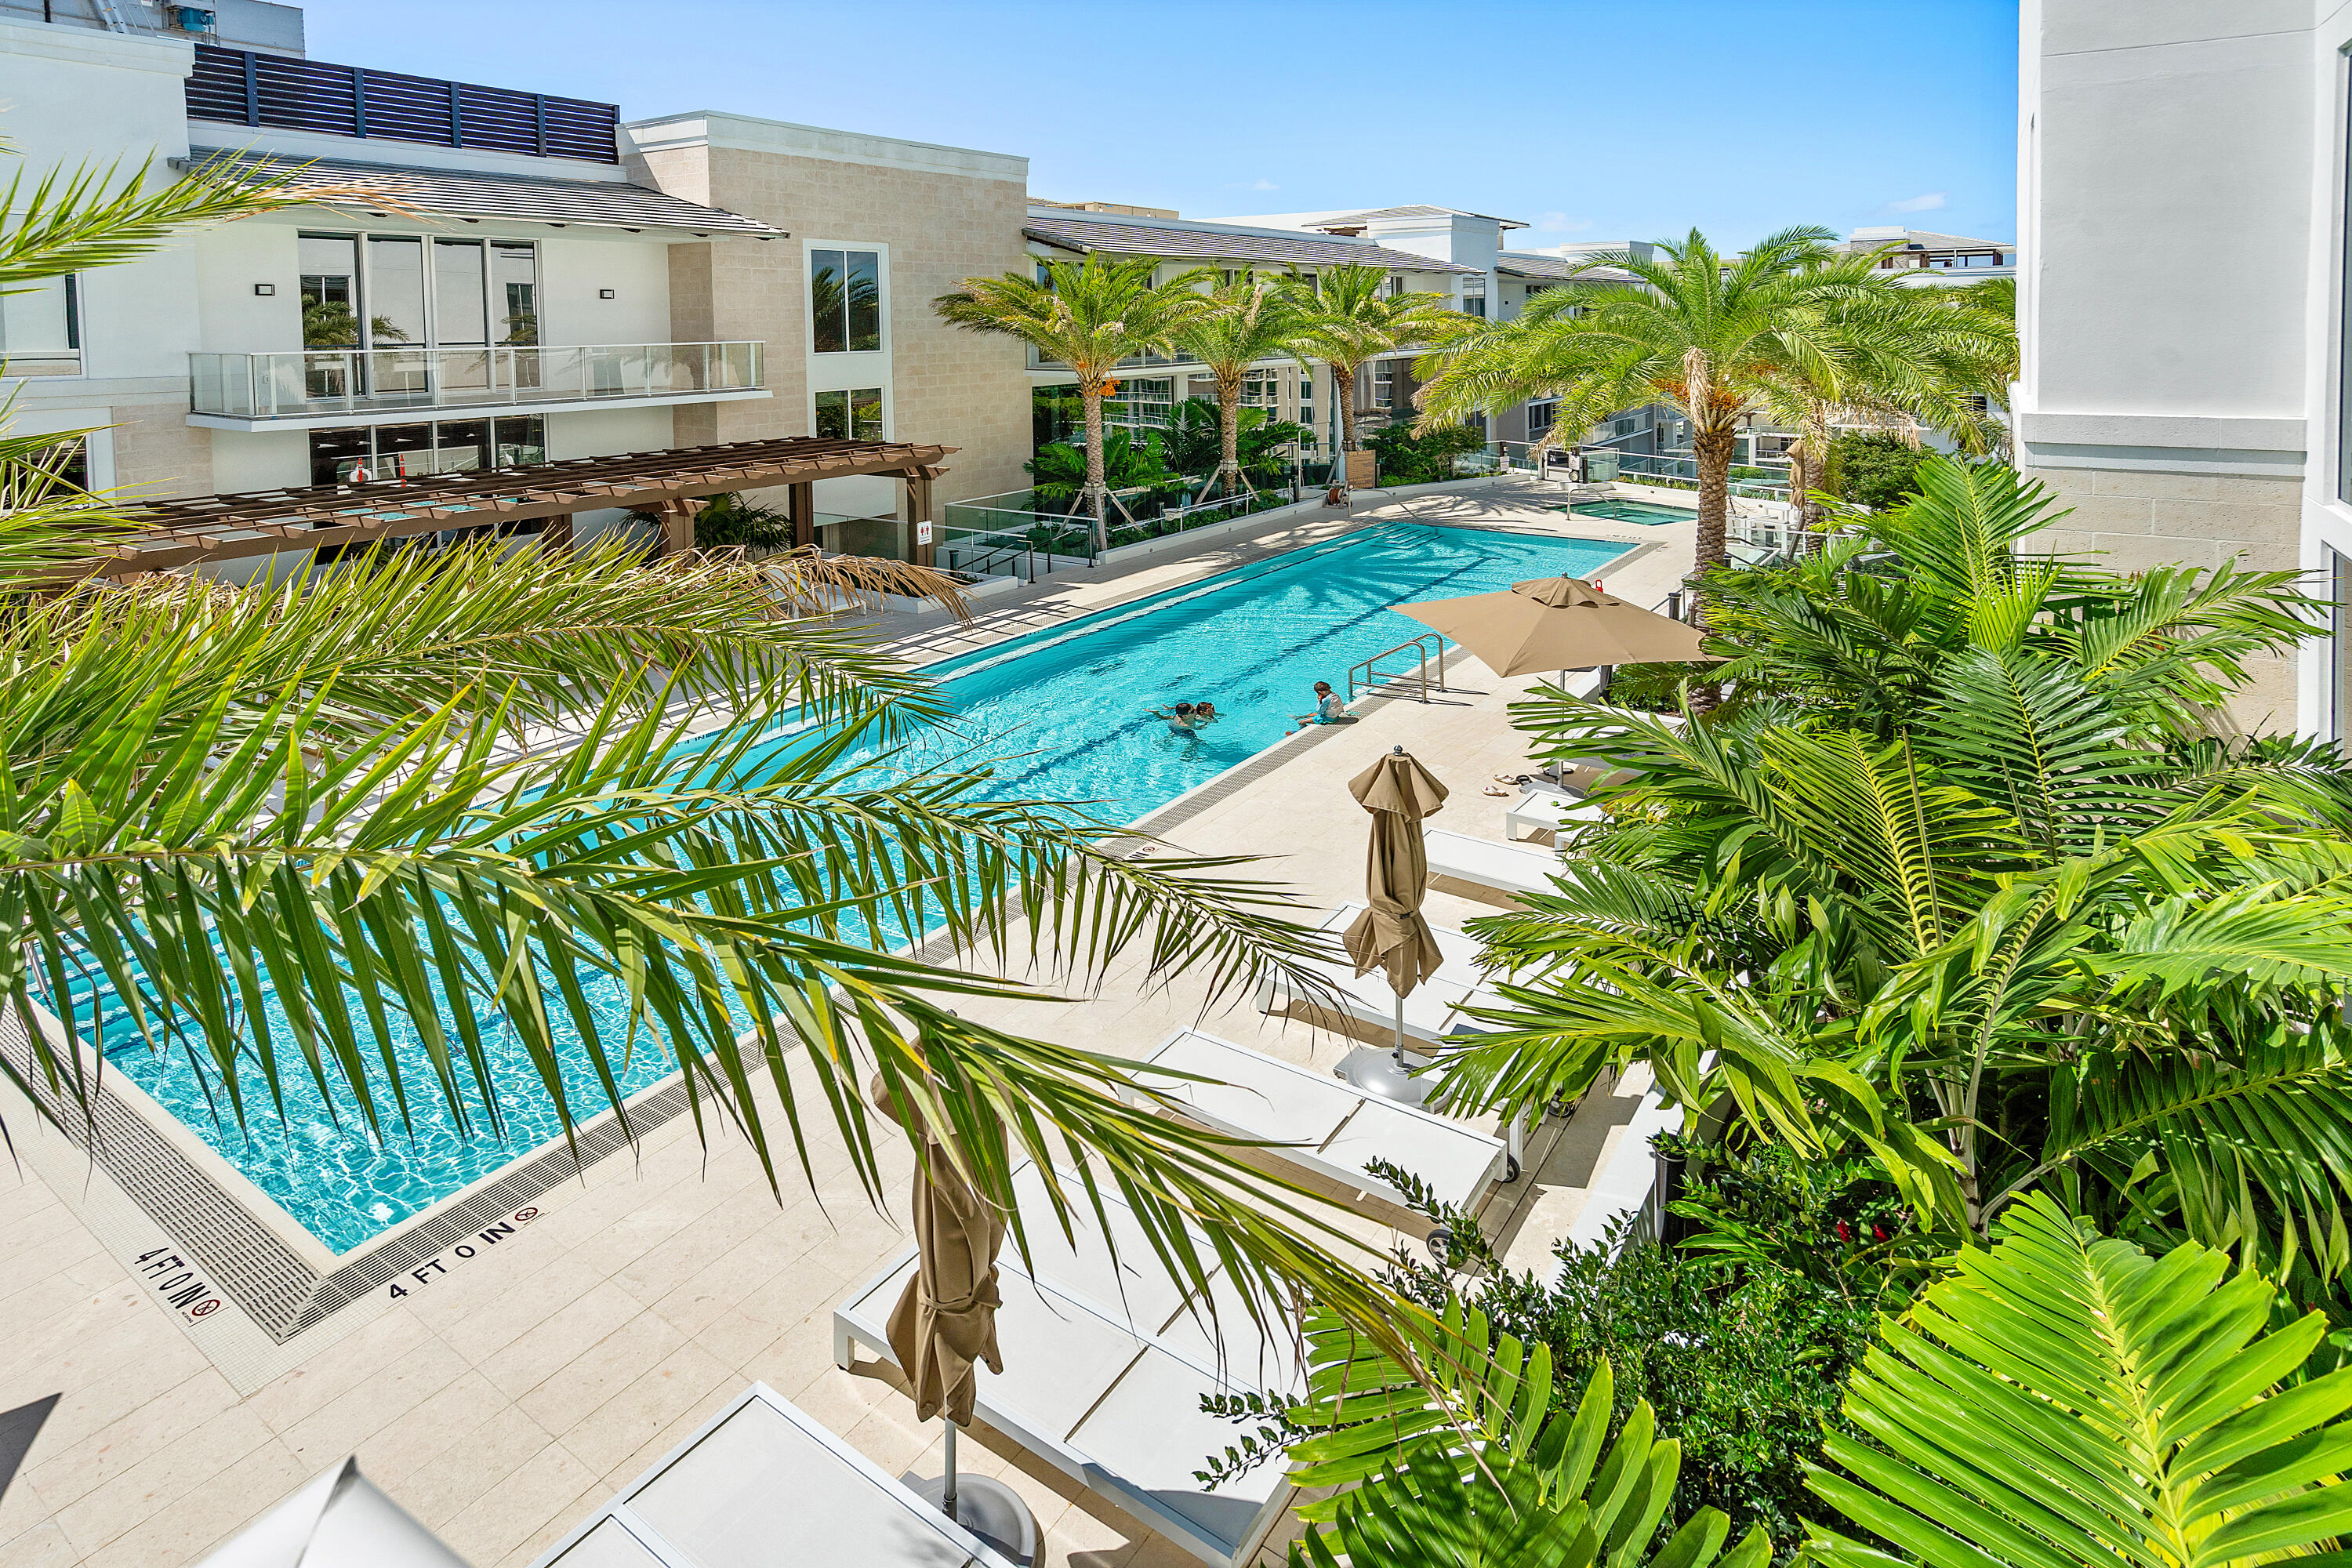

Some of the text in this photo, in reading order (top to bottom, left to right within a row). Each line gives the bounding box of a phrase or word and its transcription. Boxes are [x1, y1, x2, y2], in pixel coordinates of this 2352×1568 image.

[134, 1247, 169, 1265] 4
[142, 1254, 186, 1279] FT
[390, 1283, 408, 1299] 4
[411, 1258, 447, 1284] FT
[478, 1221, 516, 1245] IN
[167, 1282, 211, 1309] IN
